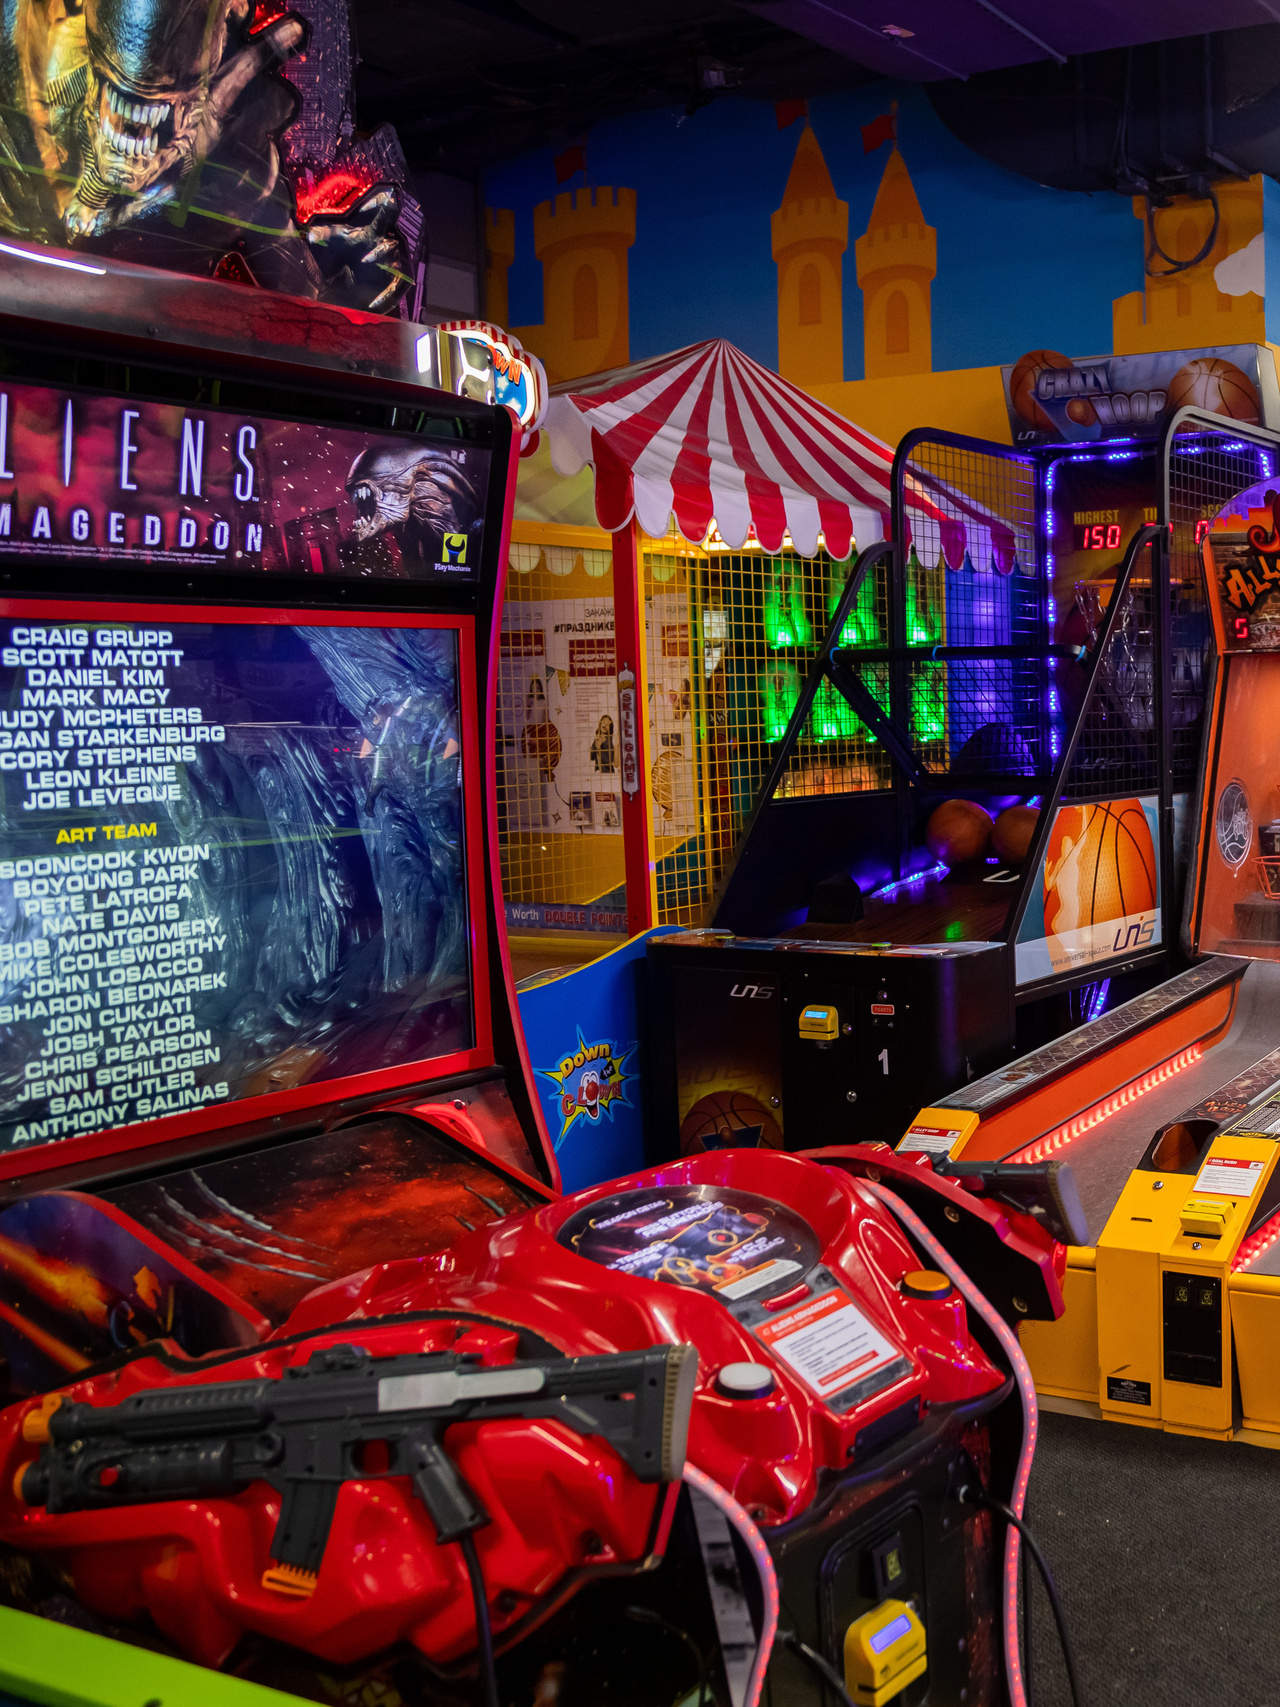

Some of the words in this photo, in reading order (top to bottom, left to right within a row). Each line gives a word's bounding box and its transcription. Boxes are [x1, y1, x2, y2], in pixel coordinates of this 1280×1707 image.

[1037, 360, 1112, 400] CRAZY
[1089, 389, 1168, 427] HOOP
[1074, 509, 1119, 525] HIGHEST
[1083, 524, 1122, 549] 150
[12, 627, 89, 646] CRAIG
[96, 630, 173, 647] GRUPP
[2, 649, 84, 666] SCOTT
[92, 650, 184, 667] MATOTT
[28, 669, 116, 686] DANIEL
[122, 670, 164, 686] KIM
[23, 689, 96, 706] MARK
[103, 688, 170, 705] MACY
[0, 710, 55, 728] UDY
[63, 708, 202, 727] MCPHETERS
[622, 693, 633, 738] SKILL
[58, 726, 226, 747] STARKENBURG
[0, 750, 68, 770] CORY
[78, 745, 197, 766] STEPHENS
[624, 743, 635, 783] GAME
[26, 770, 91, 790] LEON
[98, 765, 176, 785] KLEINE
[23, 790, 71, 810] JOE
[78, 784, 181, 807] LEVEQUE
[56, 827, 96, 844] ART
[102, 822, 157, 840] TEAM
[144, 844, 210, 866] KWON
[13, 870, 134, 898] BOYOUNG
[140, 863, 199, 885] PARK
[24, 894, 85, 918] PETE
[92, 883, 192, 910] LATROFA
[512, 908, 539, 920] Worth
[544, 910, 586, 925] DOUBLE
[590, 912, 629, 926] POINTS
[42, 911, 105, 936] NATE
[113, 903, 180, 927] DAVIS
[0, 939, 50, 962] BOB
[58, 917, 220, 955] MONTGOMERY
[59, 934, 227, 974] COLESWORTHY
[22, 973, 90, 999] JOHN
[97, 956, 203, 988] LOSACCO
[0, 991, 101, 1024] SHARON
[107, 971, 227, 1006] BEDNAREK
[42, 1013, 92, 1037] JON
[99, 996, 192, 1027] CUKJATI
[40, 1030, 104, 1057] JOSH
[110, 1014, 196, 1043] TAYLOR
[24, 1051, 98, 1080] CHRIS
[105, 1030, 212, 1064] PEARSON
[878, 1048, 889, 1075] 1
[16, 1073, 88, 1102] JENNI
[96, 1047, 221, 1086] SCHILDGEN
[49, 1089, 104, 1116] SAM
[111, 1070, 196, 1101] CUTLER
[12, 1102, 129, 1144] ANTHONY
[136, 1082, 229, 1116] SALINAS
